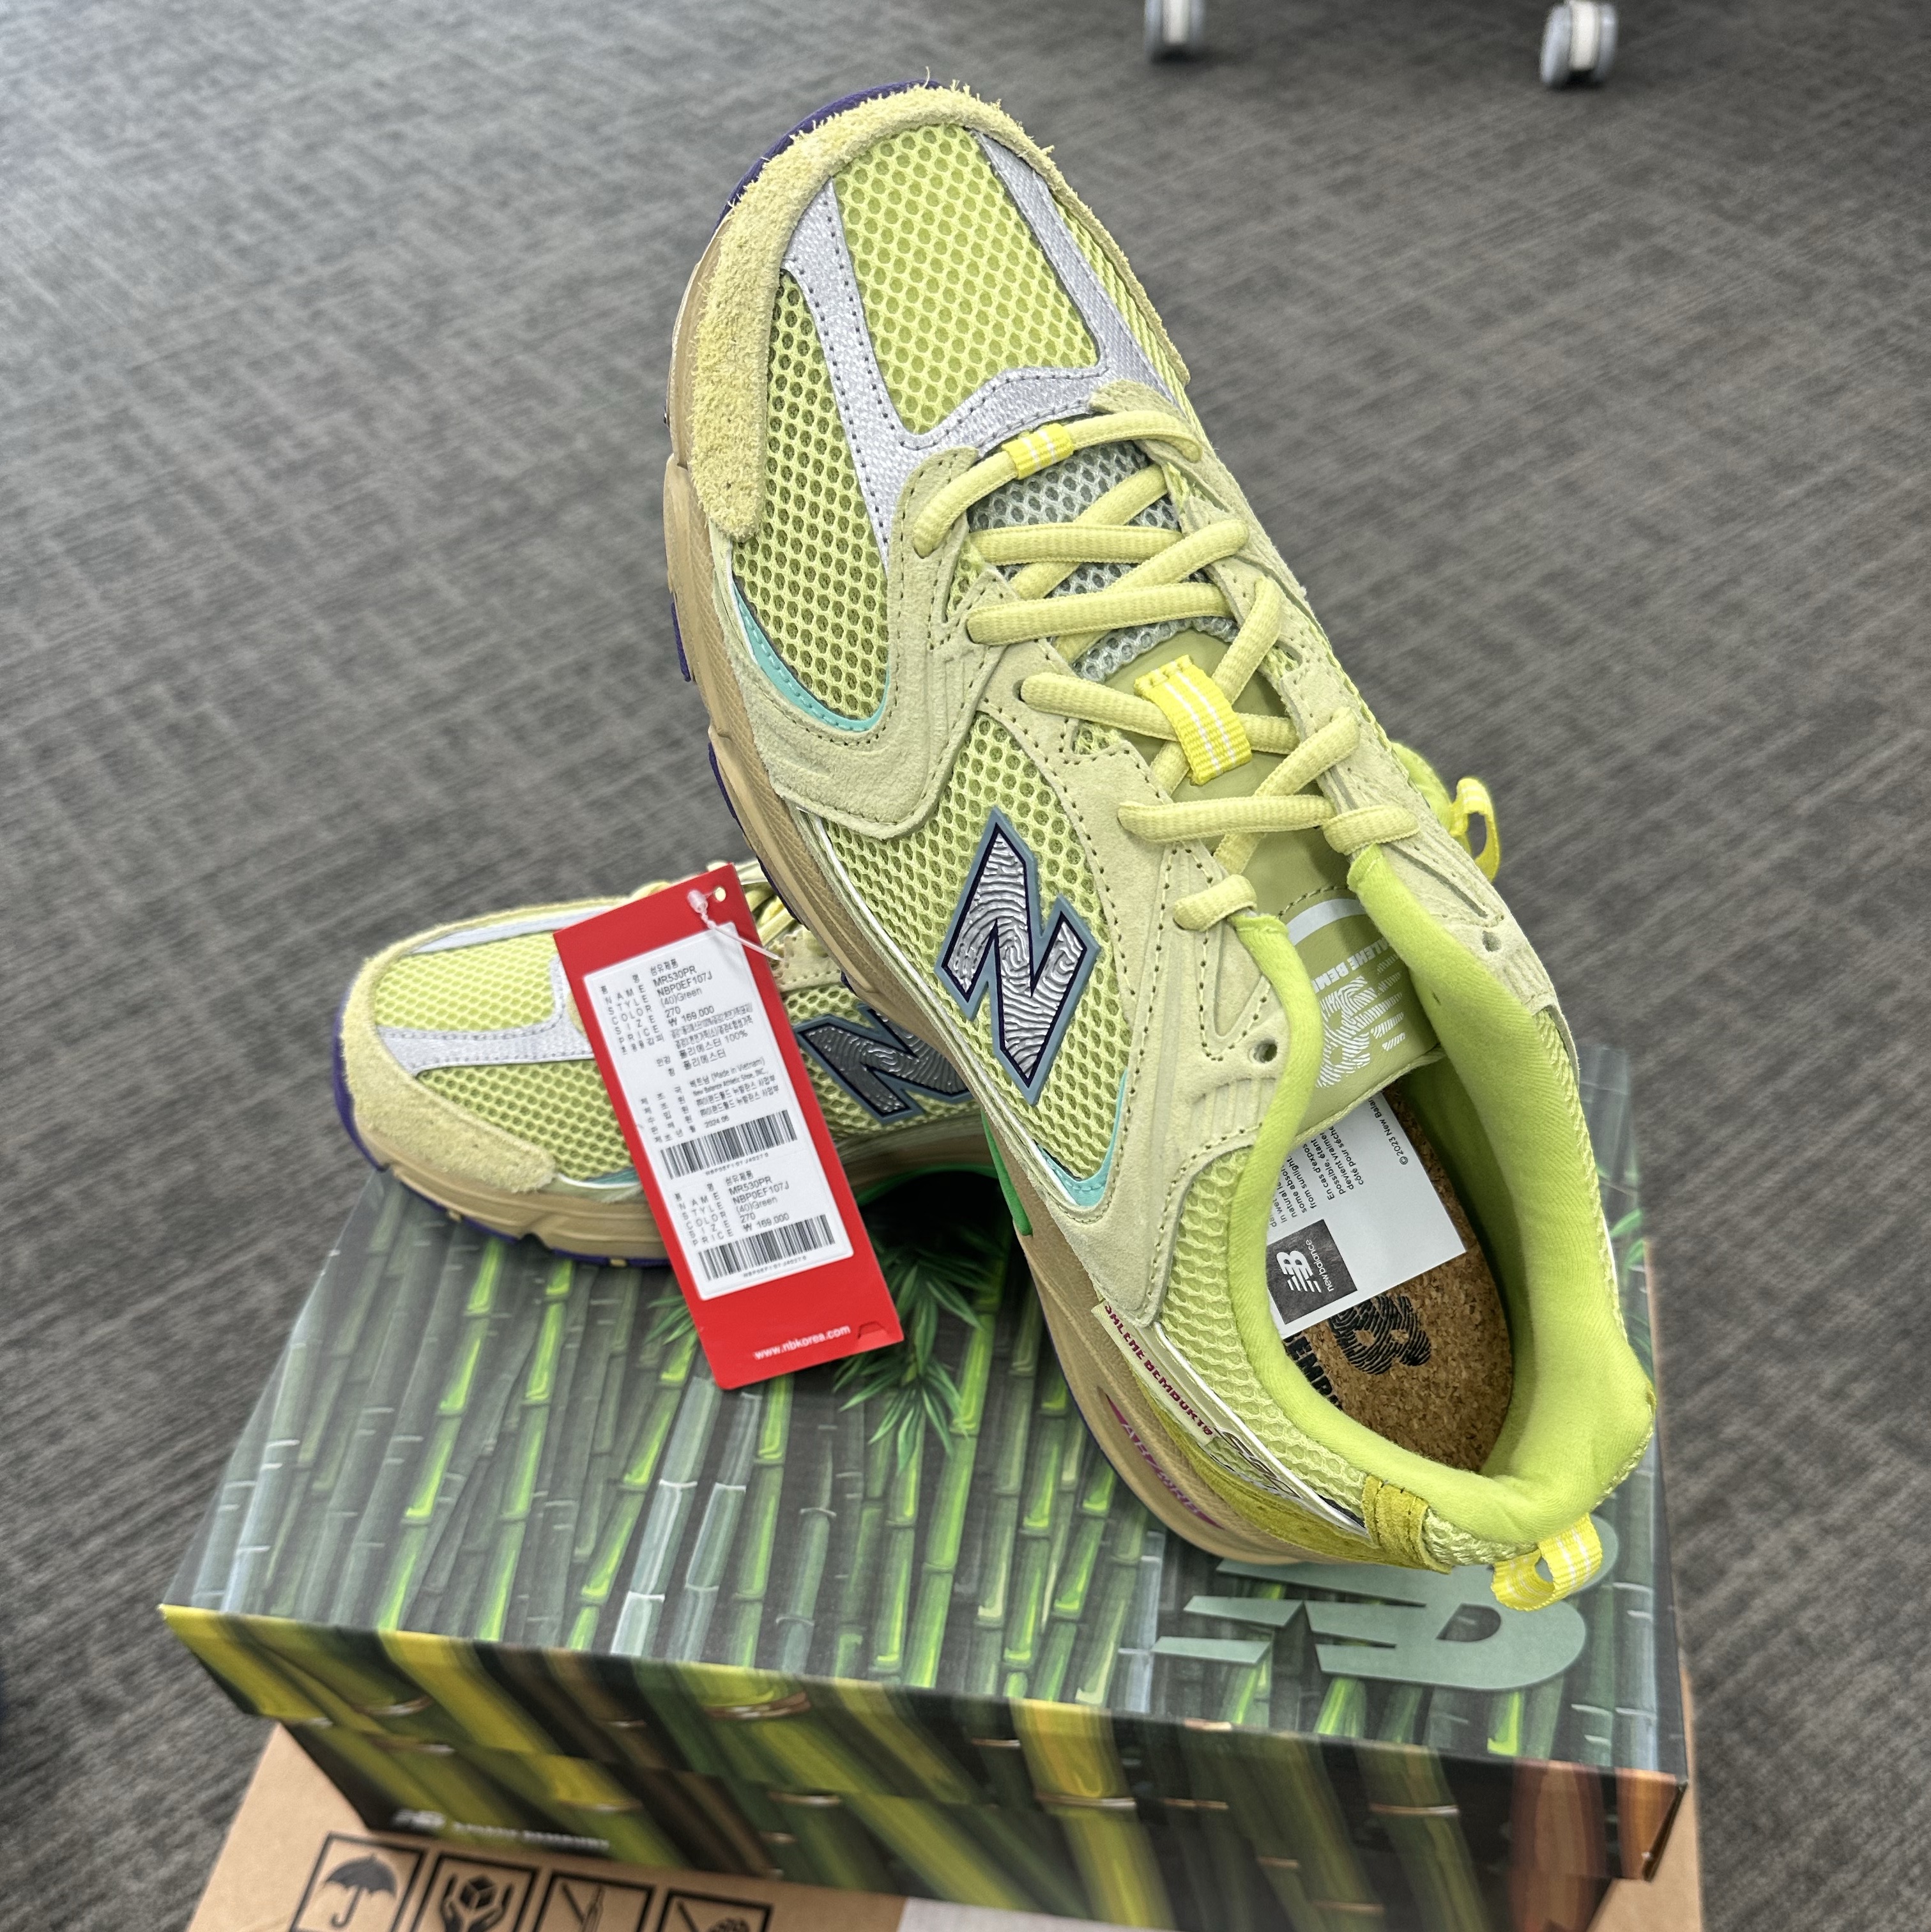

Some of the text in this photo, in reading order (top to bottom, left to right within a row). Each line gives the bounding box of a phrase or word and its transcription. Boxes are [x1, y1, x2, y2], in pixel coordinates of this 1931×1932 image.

[1347, 937, 1390, 971] ALEHE
[604, 965, 698, 1005] NAME MR530PR
[607, 994, 649, 1016] STYLE
[611, 1004, 653, 1025] COLOR
[660, 988, 703, 1008] (40)Green
[614, 1015, 656, 1036] SIZE
[664, 1006, 681, 1018] 270
[618, 1024, 660, 1045] PRICE
[724, 1029, 748, 1043] 100%
[1368, 1096, 1382, 1119] Balan
[1380, 1119, 1392, 1137] New
[1311, 1138, 1346, 1195] possible, étant
[1328, 1126, 1364, 1185] côté pour séche
[1302, 1143, 1334, 1200] En cas d'expos
[1335, 1161, 1354, 1190] devient
[678, 1176, 772, 1210] NAME MR530PR
[1279, 1190, 1297, 1218] natural
[1293, 1191, 1307, 1213] some
[1304, 1190, 1317, 1209] from
[682, 1201, 724, 1221] STYLE
[685, 1196, 778, 1230] COLOR (40)Green
[688, 1211, 756, 1239] SIZE 270
[692, 1228, 734, 1246] PRICE
[754, 1325, 851, 1360] www.nbkorea.com
